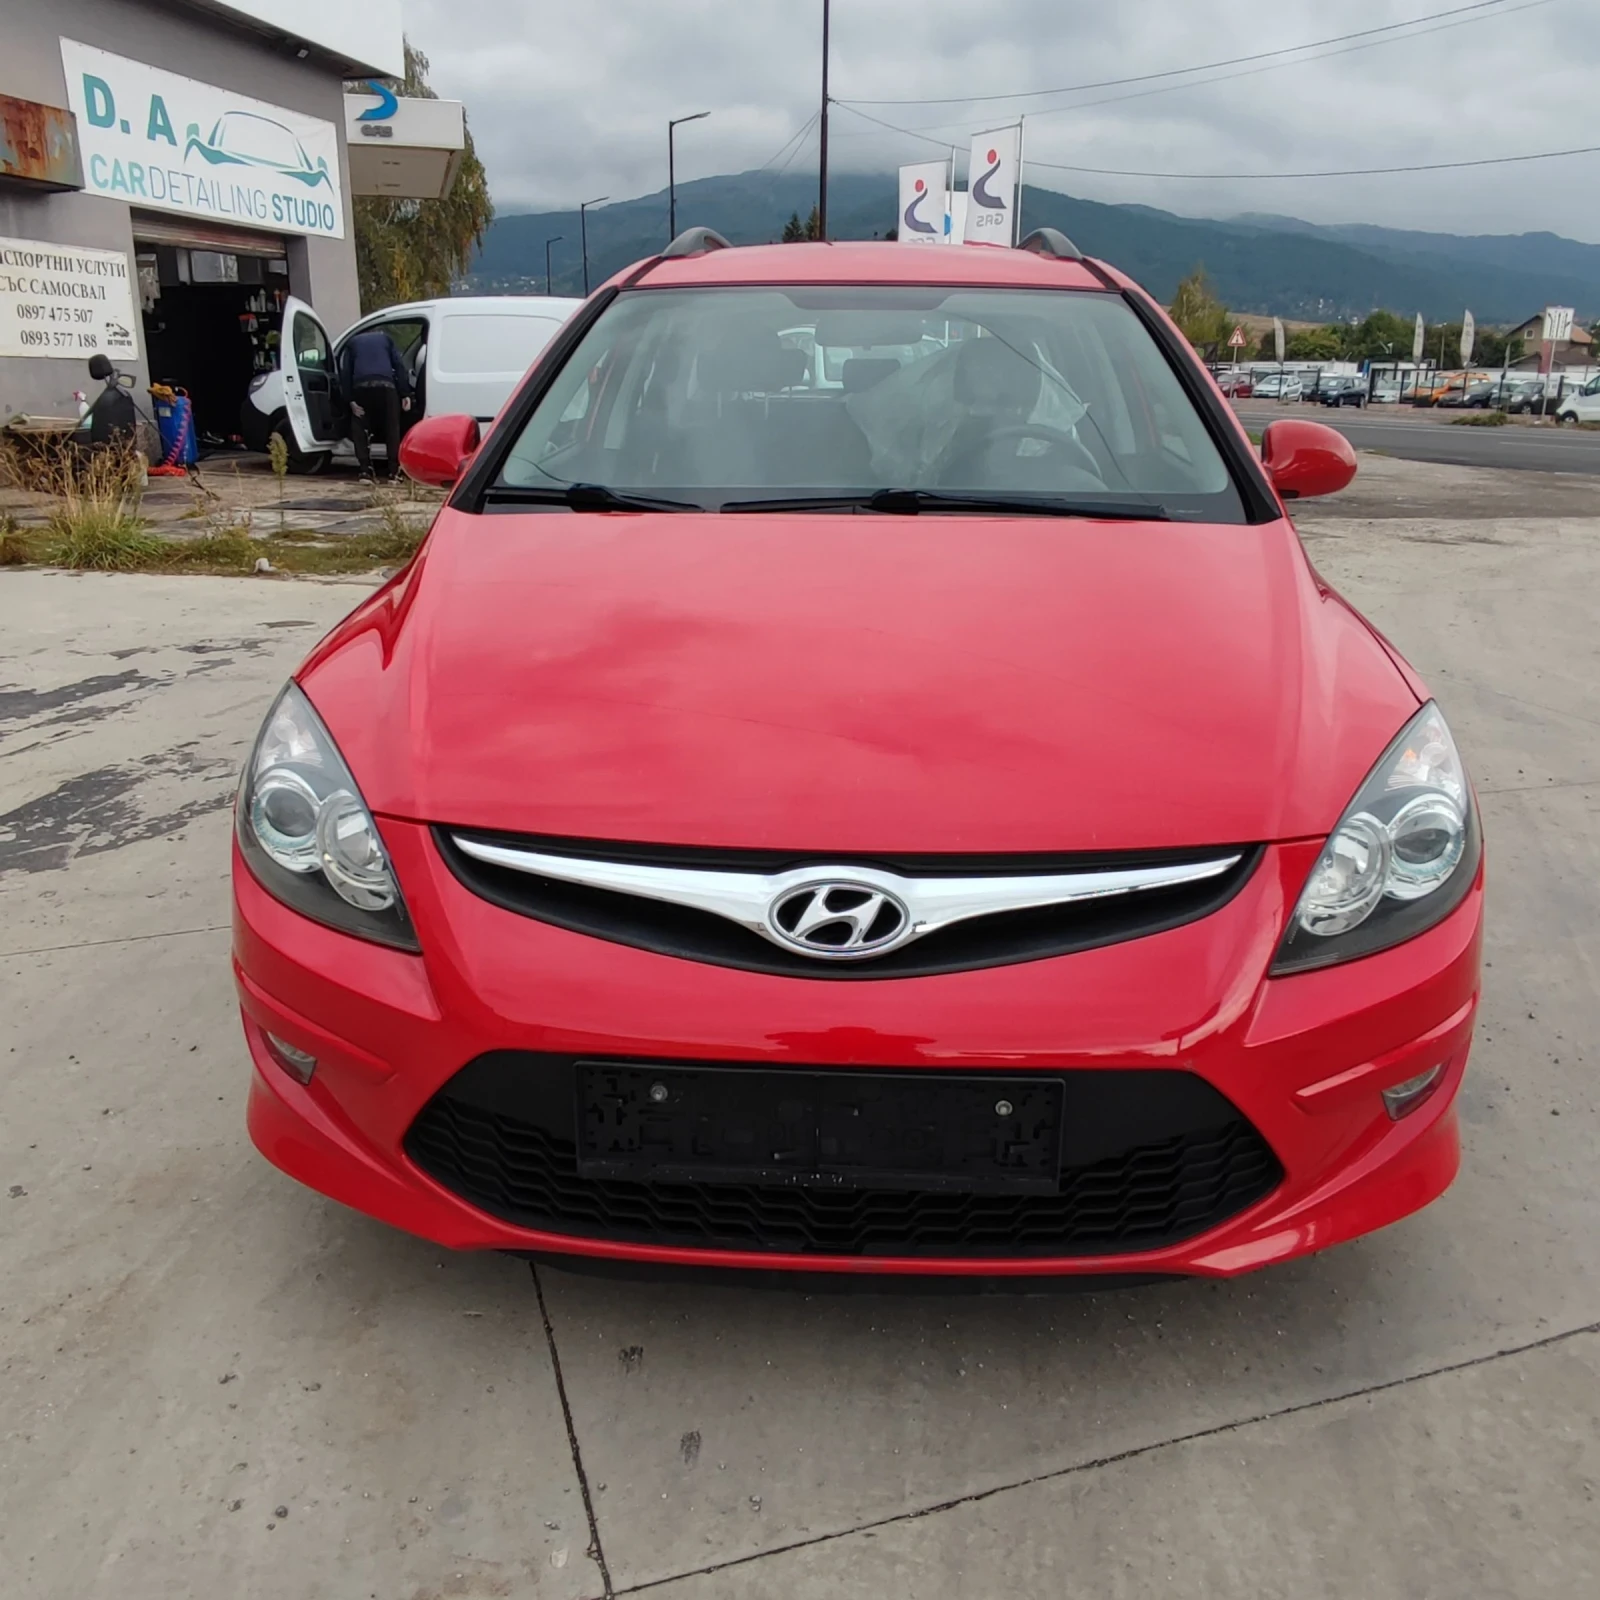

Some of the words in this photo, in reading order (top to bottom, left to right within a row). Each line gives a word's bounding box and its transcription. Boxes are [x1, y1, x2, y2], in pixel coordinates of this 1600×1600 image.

[83, 73, 131, 135] D.
[147, 94, 177, 146] A
[271, 193, 334, 231] STUDIO
[0, 249, 73, 273] СПОРТНИ
[76, 258, 126, 278] УСЛУГИ
[30, 279, 106, 300] САМОСВАЛ
[16, 304, 46, 321] 0897
[49, 307, 71, 322] 475
[73, 308, 93, 324] 507
[20, 330, 50, 346] 0893
[54, 332, 73, 347] 577
[78, 333, 97, 348] 188
